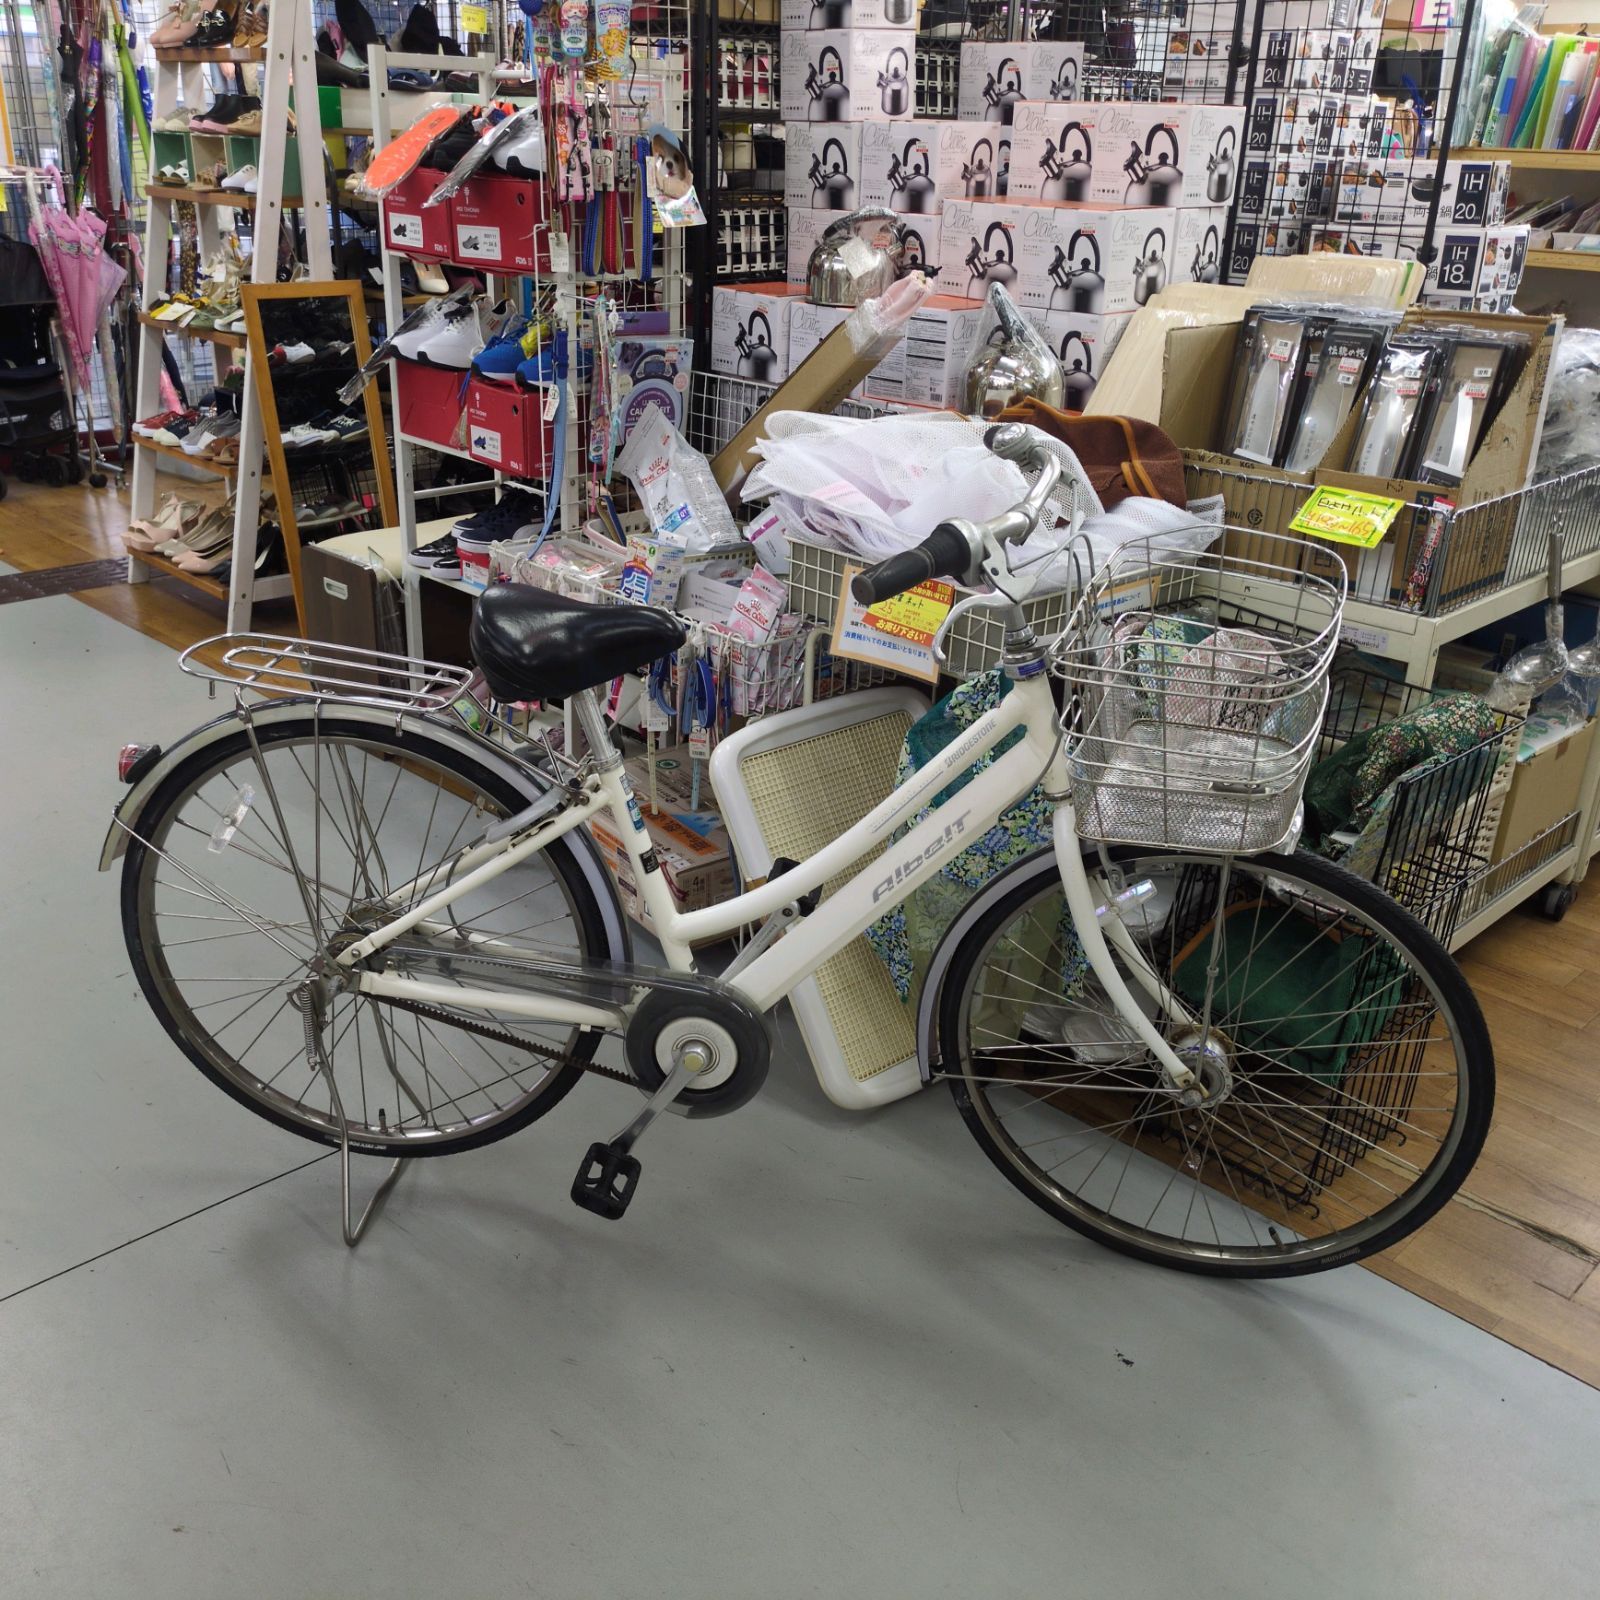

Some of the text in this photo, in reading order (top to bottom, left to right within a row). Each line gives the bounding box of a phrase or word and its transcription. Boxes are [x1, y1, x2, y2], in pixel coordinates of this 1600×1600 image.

[1270, 40, 1286, 57] IH
[1257, 105, 1272, 121] IH
[1463, 173, 1484, 191] IH
[1239, 231, 1254, 245] IH
[1452, 246, 1469, 261] IH
[1233, 255, 1249, 270] 20
[944, 716, 998, 770] BRIDGESTONE
